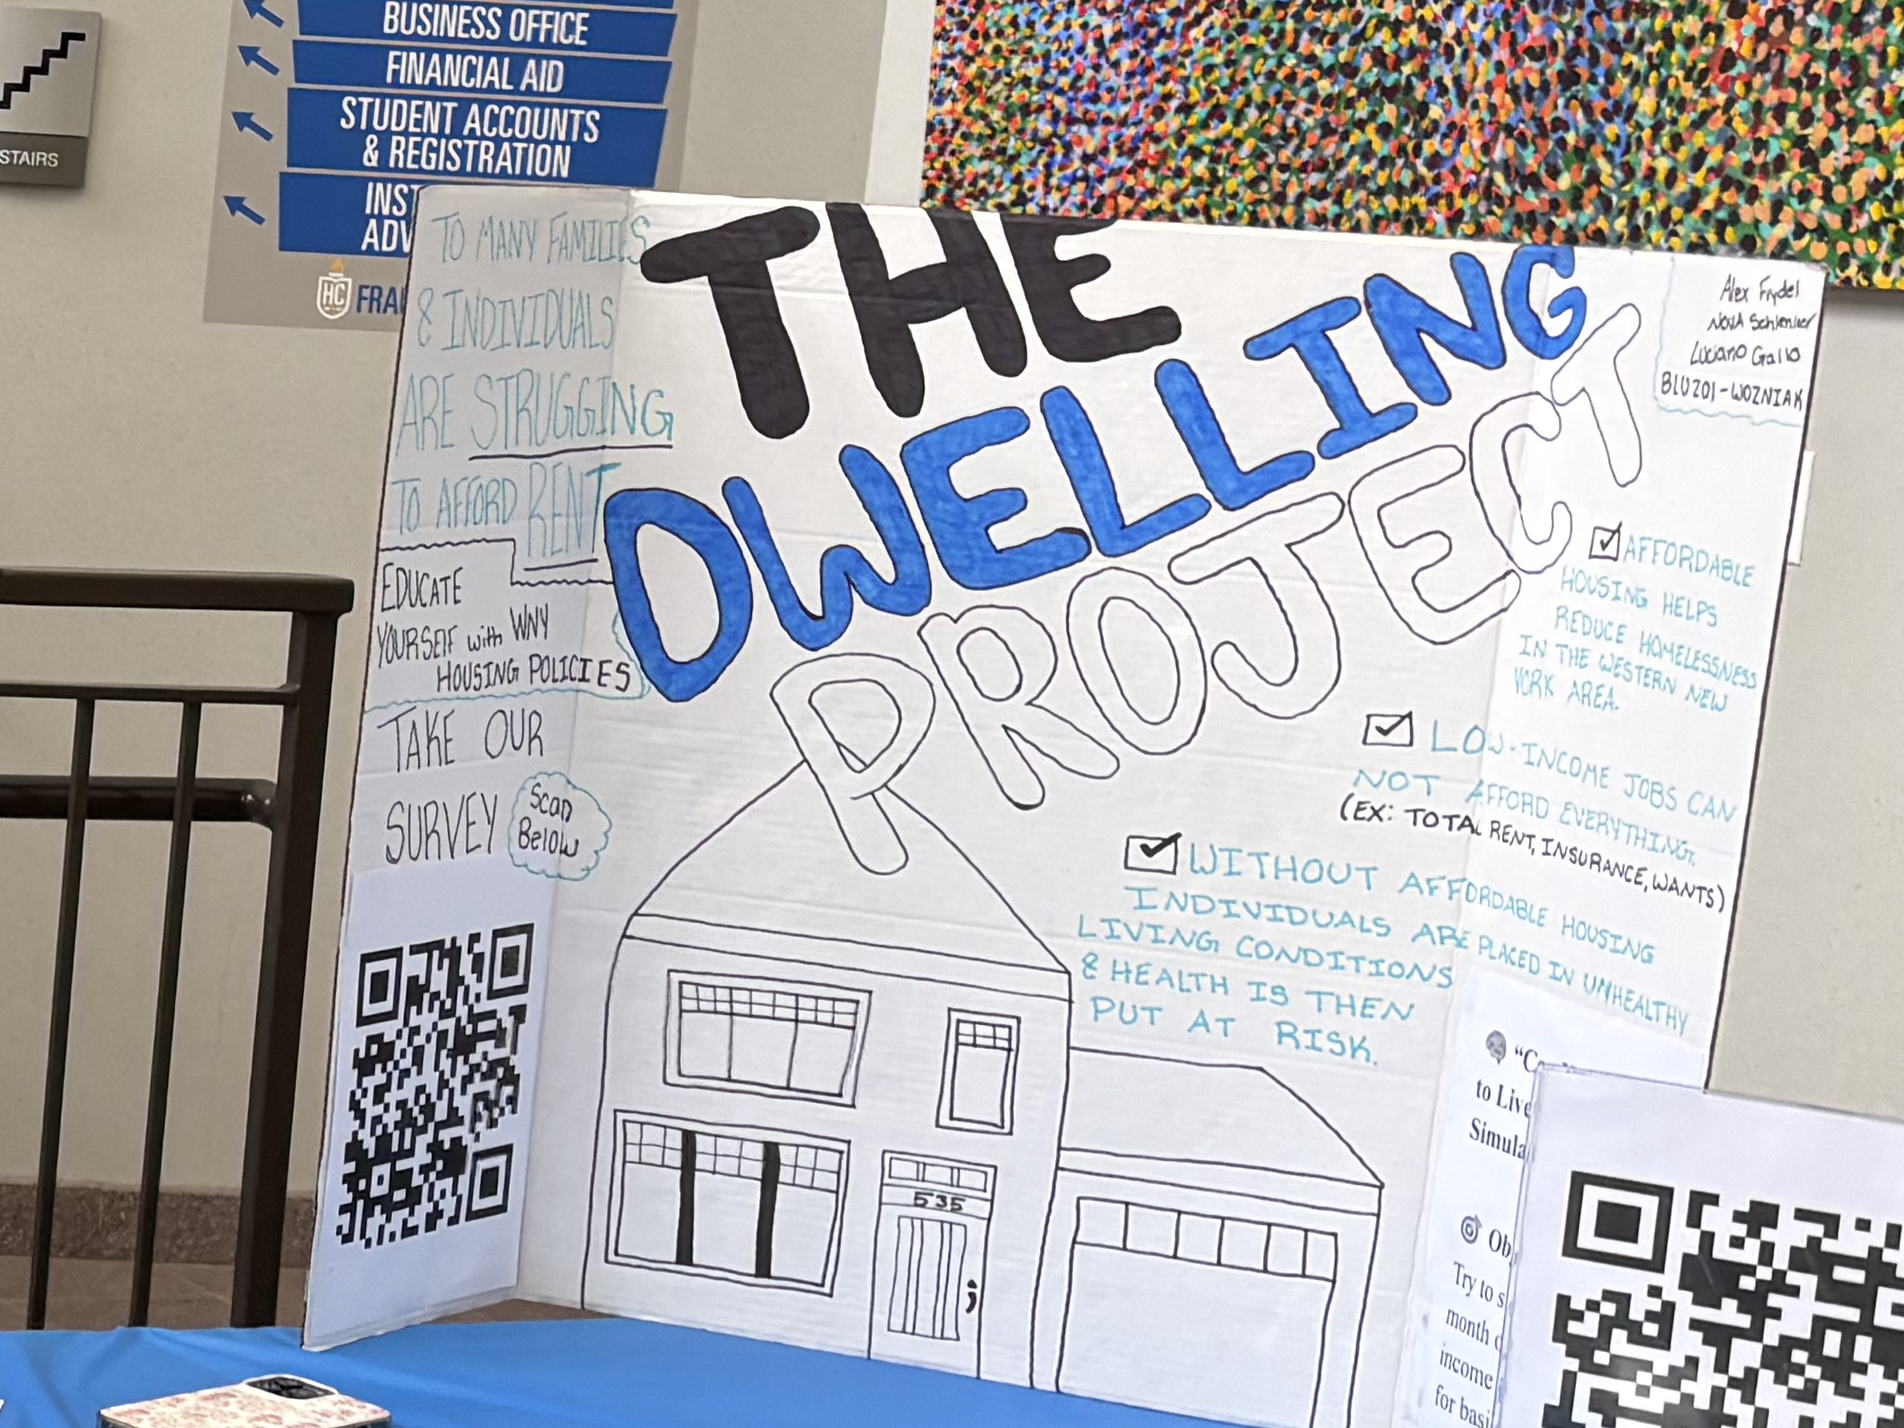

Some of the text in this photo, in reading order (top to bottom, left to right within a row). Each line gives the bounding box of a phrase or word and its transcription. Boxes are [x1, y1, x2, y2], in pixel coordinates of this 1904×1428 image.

[382, 1, 590, 46] BUSINESS OFFICE
[385, 51, 565, 94] FINANCIAL AID
[340, 96, 602, 144] STUDENT ACCOUNTS
[362, 134, 572, 179] & REGISTRATION
[432, 210, 651, 265] TO MANY FAMILIES
[1719, 273, 1750, 303] Alex
[441, 288, 616, 352] INDIVIDUALS
[639, 203, 1182, 439] THE
[395, 373, 456, 452] ARE
[603, 243, 1588, 703] DWELLING
[392, 460, 622, 558] TO AFFORD RENT
[381, 562, 464, 613] EDUCATE
[1623, 534, 1755, 588] AFFORDABLE
[770, 302, 1643, 876] PROJECT
[1560, 564, 1719, 628] HOUSING HELPS
[376, 602, 550, 669] YOURSELF with WNY
[1554, 605, 1759, 690] REDUCE HOMELESSNESS
[436, 652, 632, 693] HOUSING POLICIES
[1513, 666, 1620, 713] YORK AREA.
[1518, 634, 1729, 713] IN THE WESTERN NEW
[376, 705, 544, 774] TAKE OUR
[529, 781, 573, 824] Scan
[1339, 791, 1395, 823] (EX:
[1404, 807, 1483, 838] TOTAL
[1351, 768, 1442, 797] NOT
[1464, 779, 1550, 821] AFFORD
[1623, 772, 1677, 812] JOBS
[1686, 790, 1739, 825] CAN
[384, 791, 499, 865] SURVEY
[517, 815, 580, 858] Below
[1189, 841, 1656, 965] WITHOUT AFFORDABLE HOUSING
[1077, 913, 1454, 989] LIVING CONDITIONS
[1123, 885, 1690, 1038] INDIVIDUALS ARE PLACED IN UNHEALTHY
[1110, 957, 1230, 997] HEALTH
[1246, 980, 1290, 1007] IS
[1303, 989, 1416, 1021] THEN
[1089, 994, 1379, 1068] PUT AT RISK.
[1476, 1078, 1492, 1102] to
[1453, 1259, 1495, 1303] Try to
[1444, 1307, 1491, 1346] month
[1439, 1341, 1495, 1391] income
[1433, 1383, 1457, 1415] for
